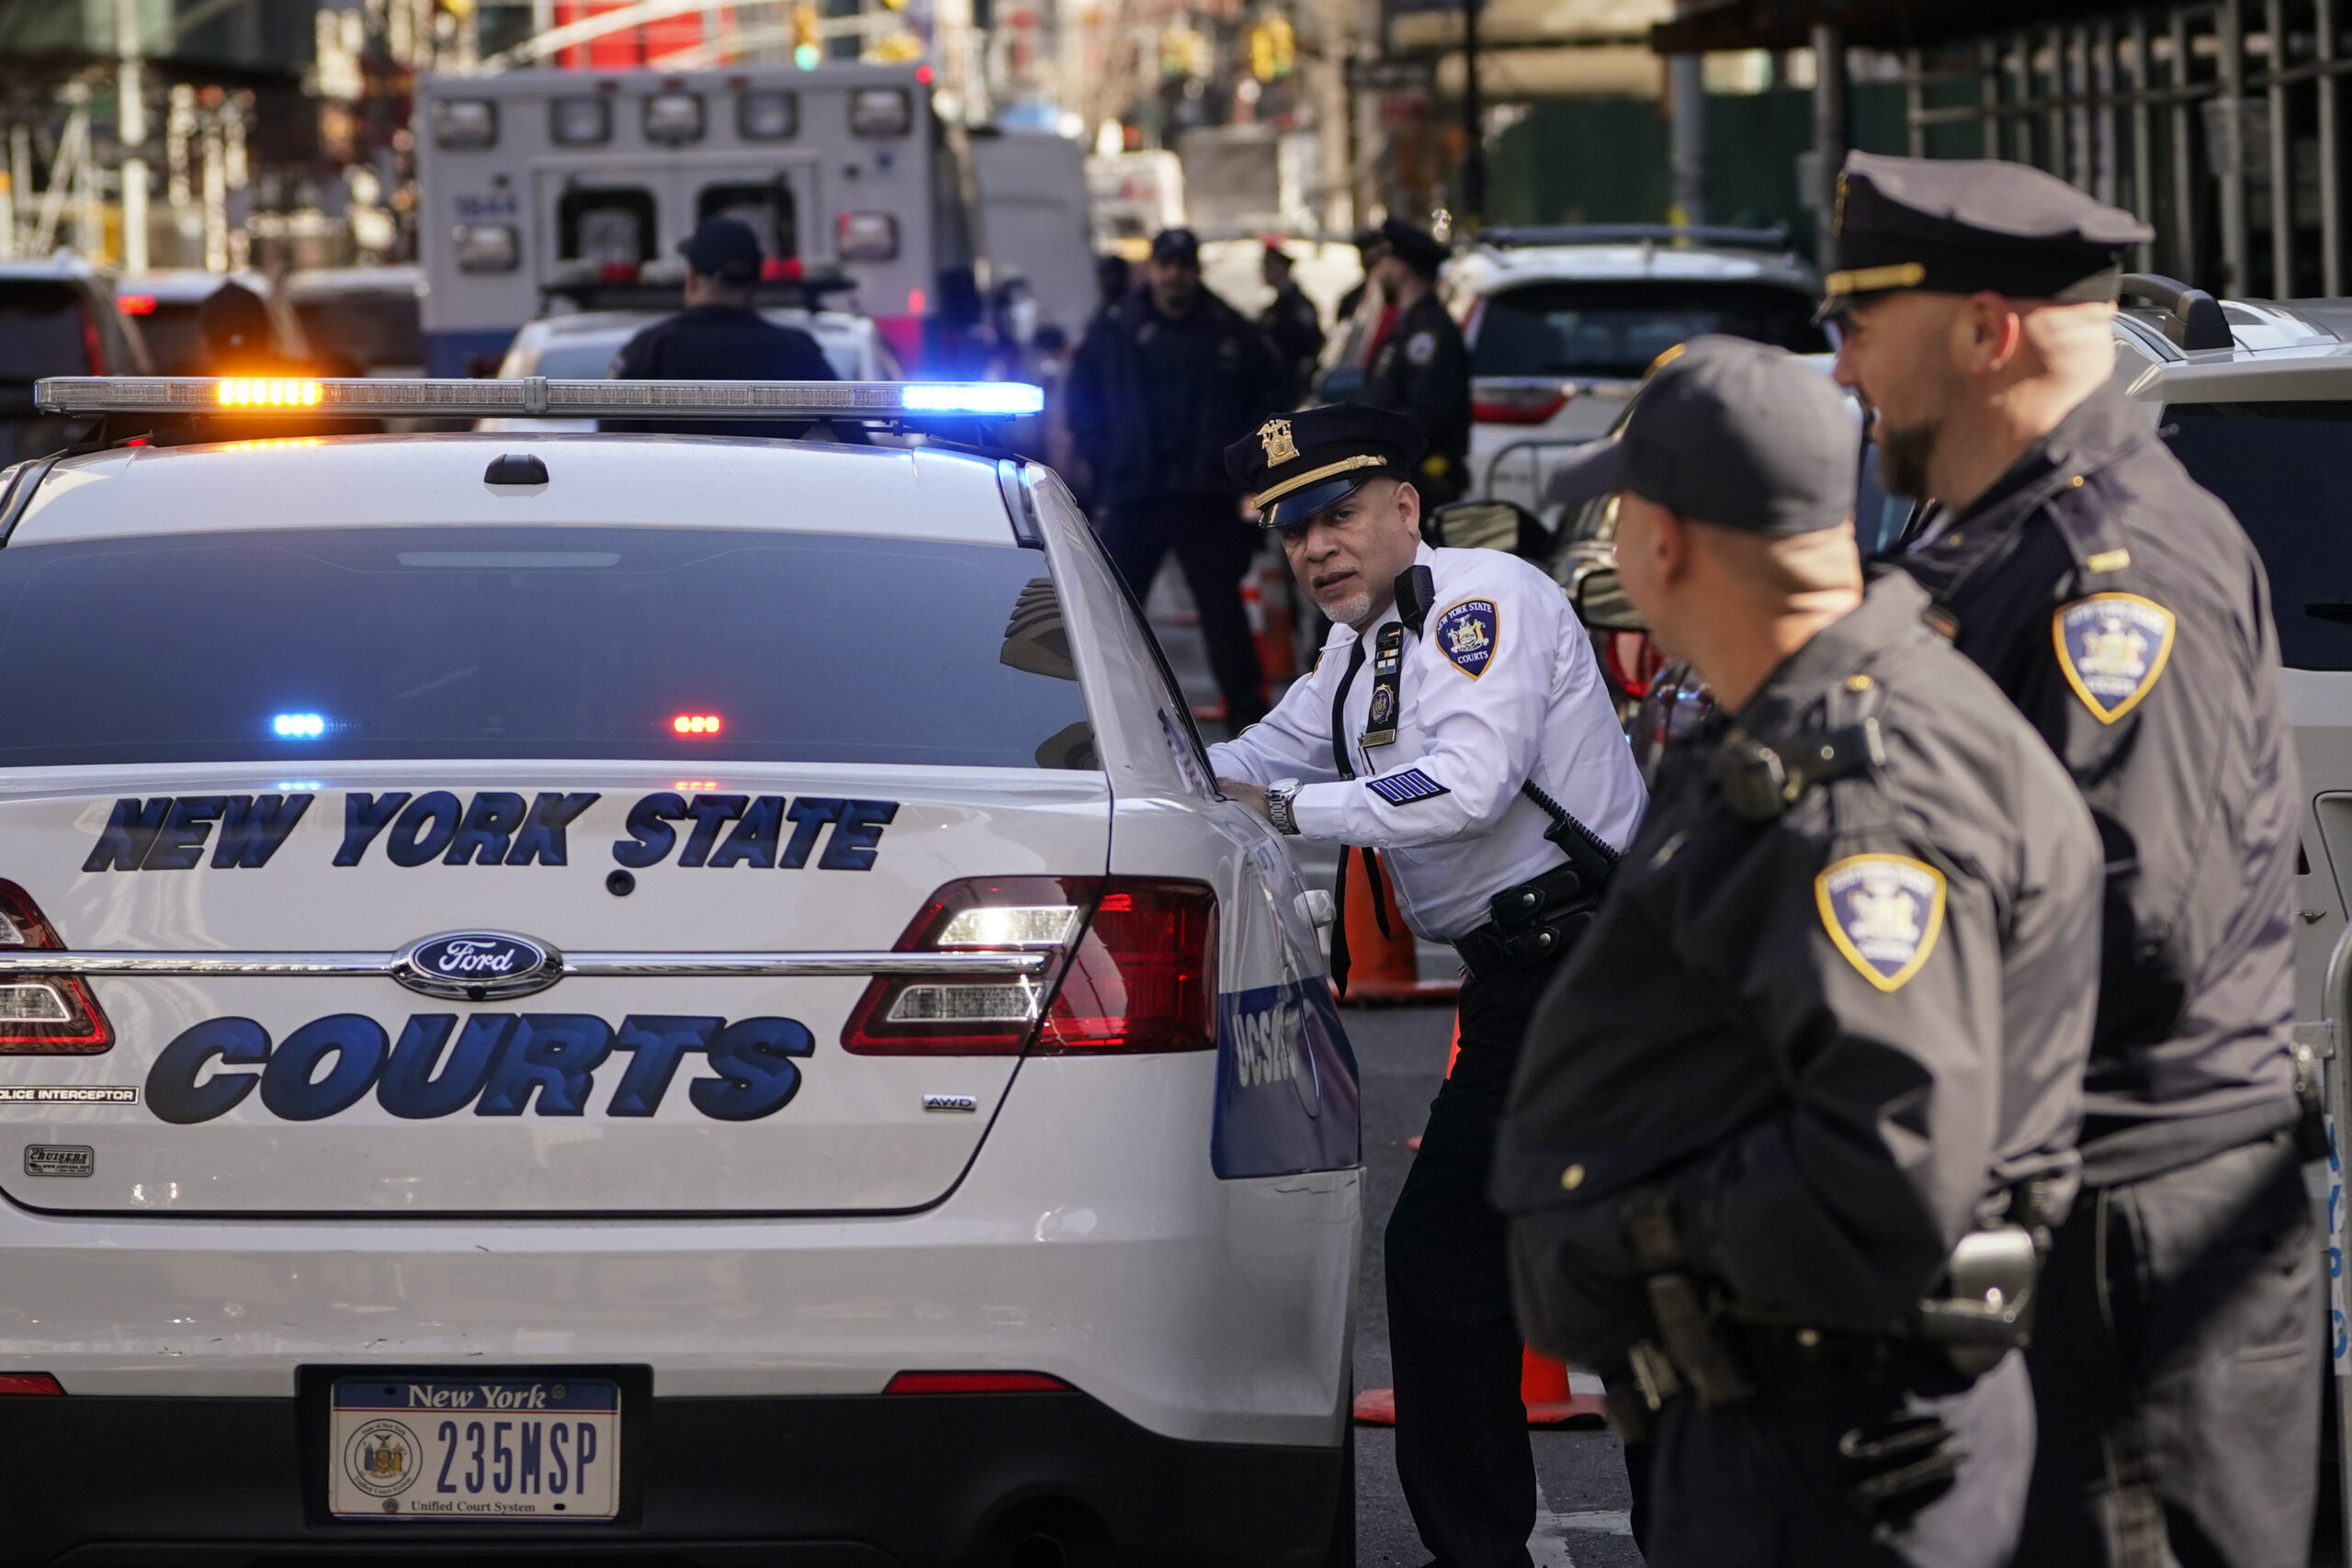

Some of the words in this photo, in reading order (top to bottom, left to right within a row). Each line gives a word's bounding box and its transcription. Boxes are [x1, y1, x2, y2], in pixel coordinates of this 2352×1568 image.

[1448, 604, 1468, 618] YORK
[1468, 602, 1492, 613] STATE
[1457, 650, 1488, 664] COURTS
[82, 794, 315, 874] NEW
[333, 791, 601, 868] YORK
[612, 792, 900, 872] STATE
[438, 940, 514, 971] Ford
[144, 1012, 816, 1124] COURTS
[0, 1089, 34, 1100] OLICE
[38, 1089, 134, 1100] INTERCEPTOR
[928, 1098, 971, 1107] AWD
[408, 1384, 473, 1407] New
[479, 1383, 547, 1409] York
[436, 1421, 596, 1495] 235MSP
[411, 1500, 453, 1512] Unified
[456, 1500, 492, 1512] Court
[494, 1501, 536, 1515] System
